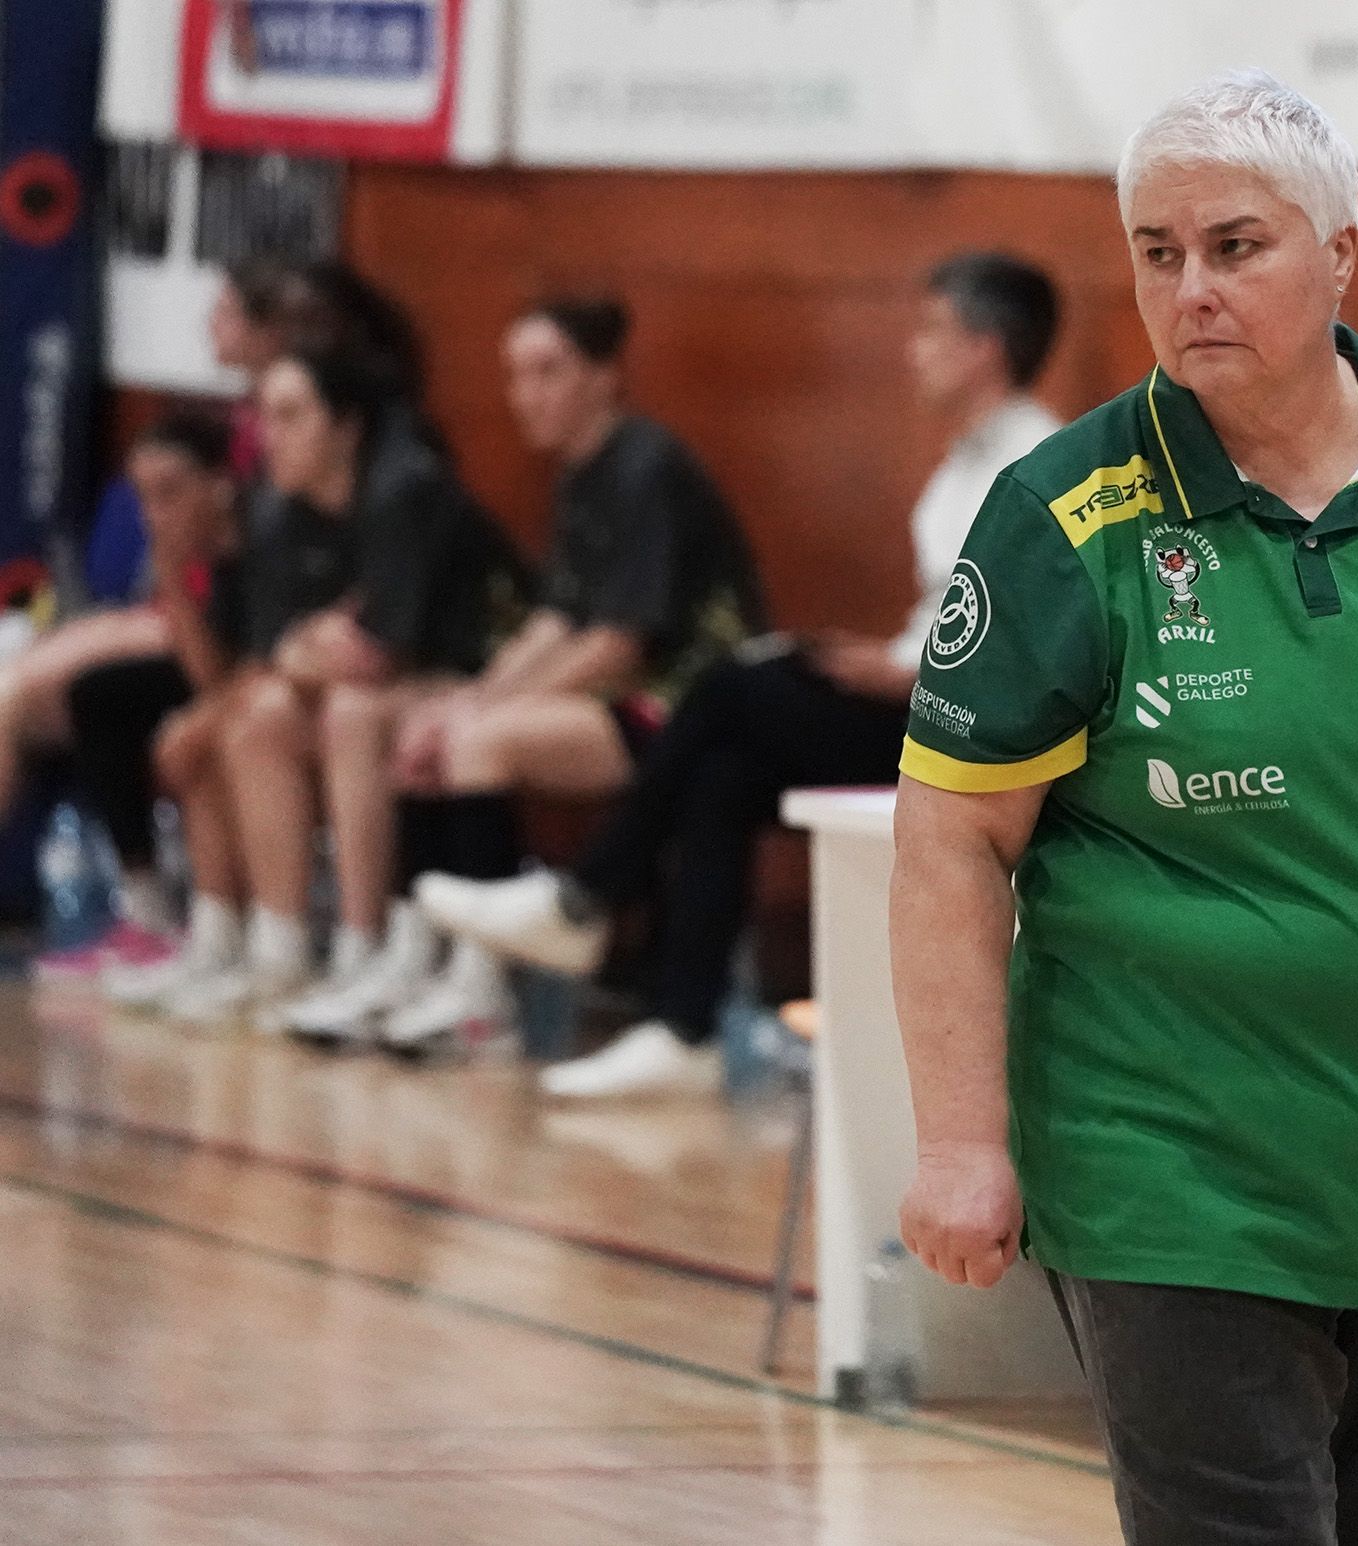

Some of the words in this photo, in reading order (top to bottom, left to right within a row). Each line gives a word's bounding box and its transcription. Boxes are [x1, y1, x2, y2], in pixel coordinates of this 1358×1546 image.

[1157, 625, 1216, 644] ARXIL
[1176, 668, 1254, 686] DEPORTE
[918, 686, 977, 726] DEPUTACIÓN
[1177, 684, 1248, 701] GALEGO
[915, 701, 971, 739] PONTEVEDRA
[1186, 765, 1287, 801] ence
